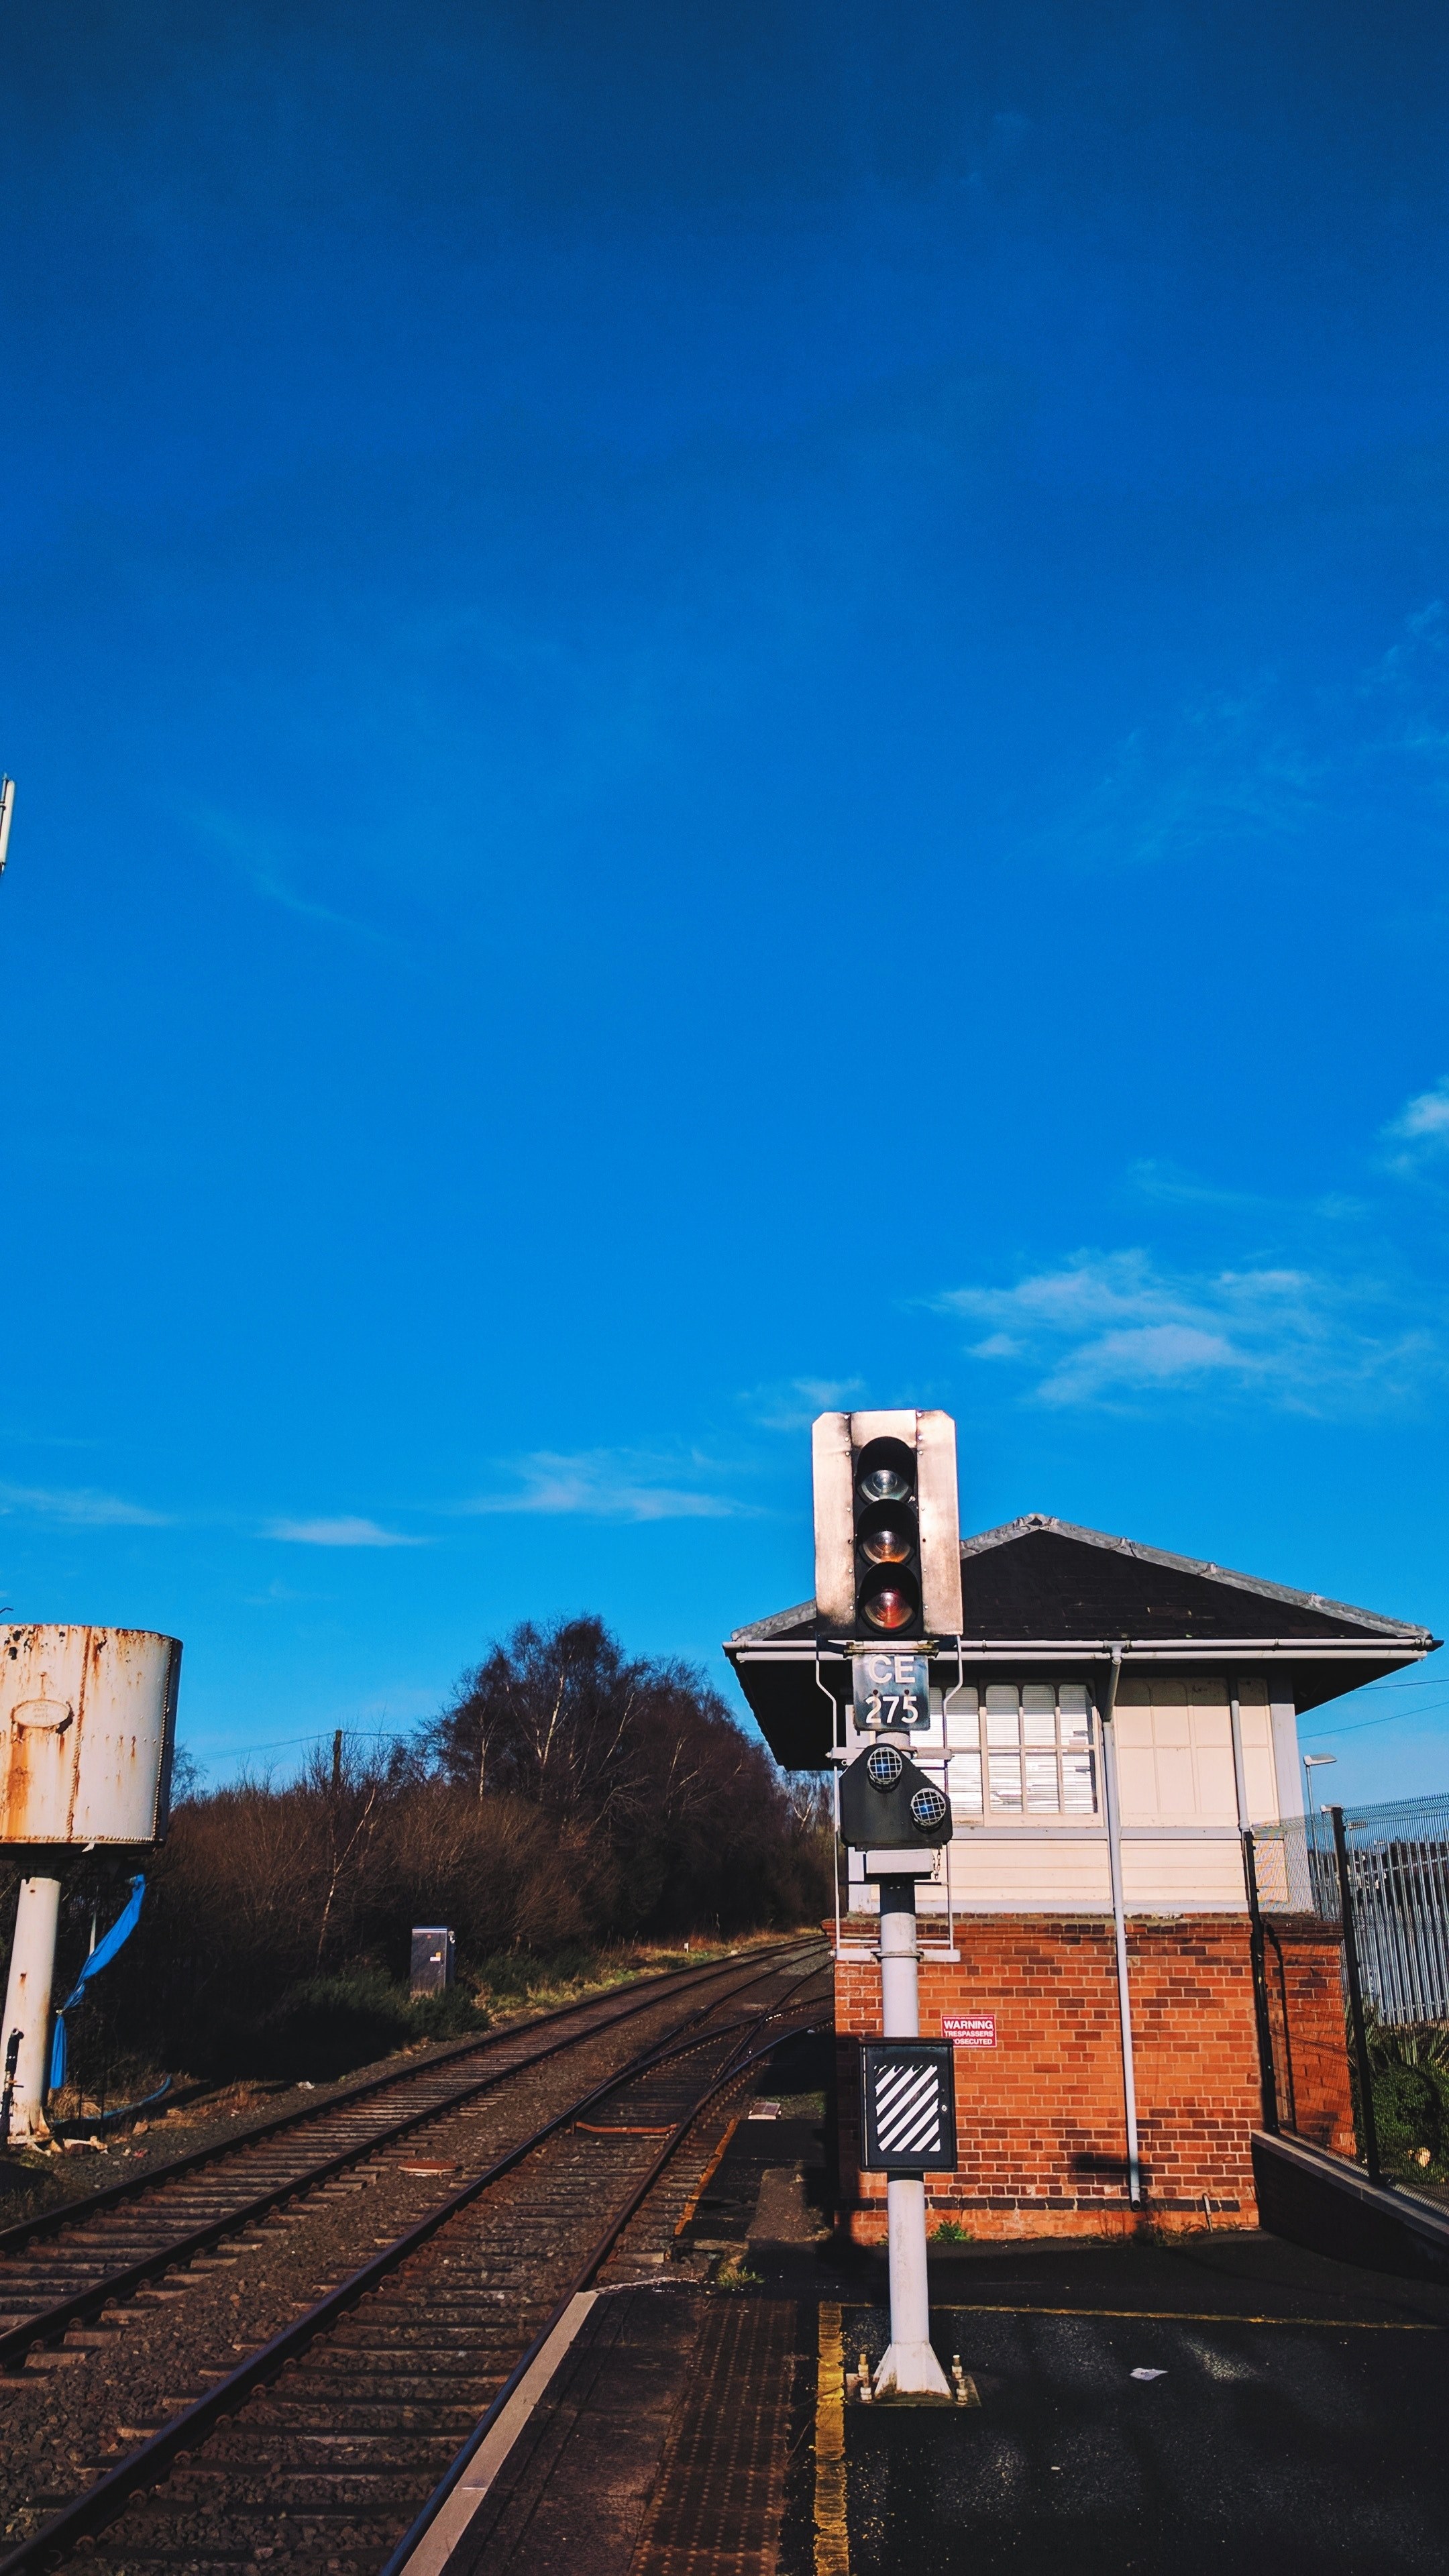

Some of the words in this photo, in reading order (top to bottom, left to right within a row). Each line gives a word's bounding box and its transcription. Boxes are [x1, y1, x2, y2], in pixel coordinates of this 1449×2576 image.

[869, 1655, 916, 1683] CE
[865, 1696, 918, 1724] 275
[944, 2021, 993, 2029] WARNING
